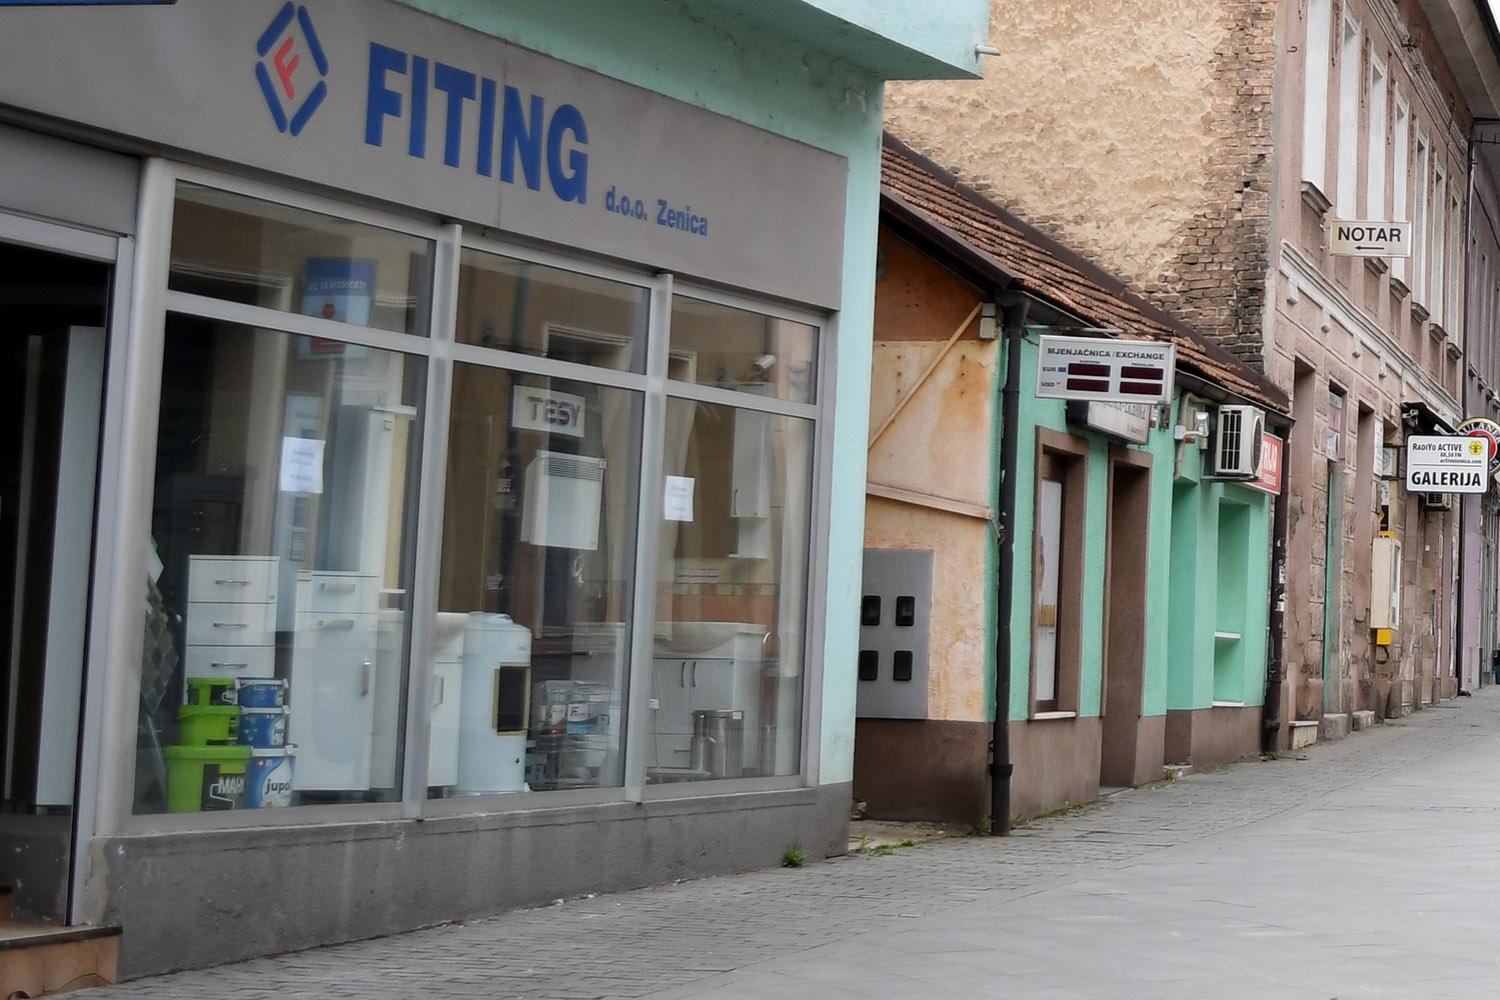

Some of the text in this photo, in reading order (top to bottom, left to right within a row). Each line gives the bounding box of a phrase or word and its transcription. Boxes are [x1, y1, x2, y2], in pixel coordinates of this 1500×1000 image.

[365, 41, 589, 205] FITING
[605, 186, 708, 237] d.o.o. Zenica
[1338, 226, 1401, 242] NOTAR
[528, 395, 580, 428] TESY
[1438, 443, 1463, 452] ACTIVE
[1411, 471, 1481, 487] GALERIJA
